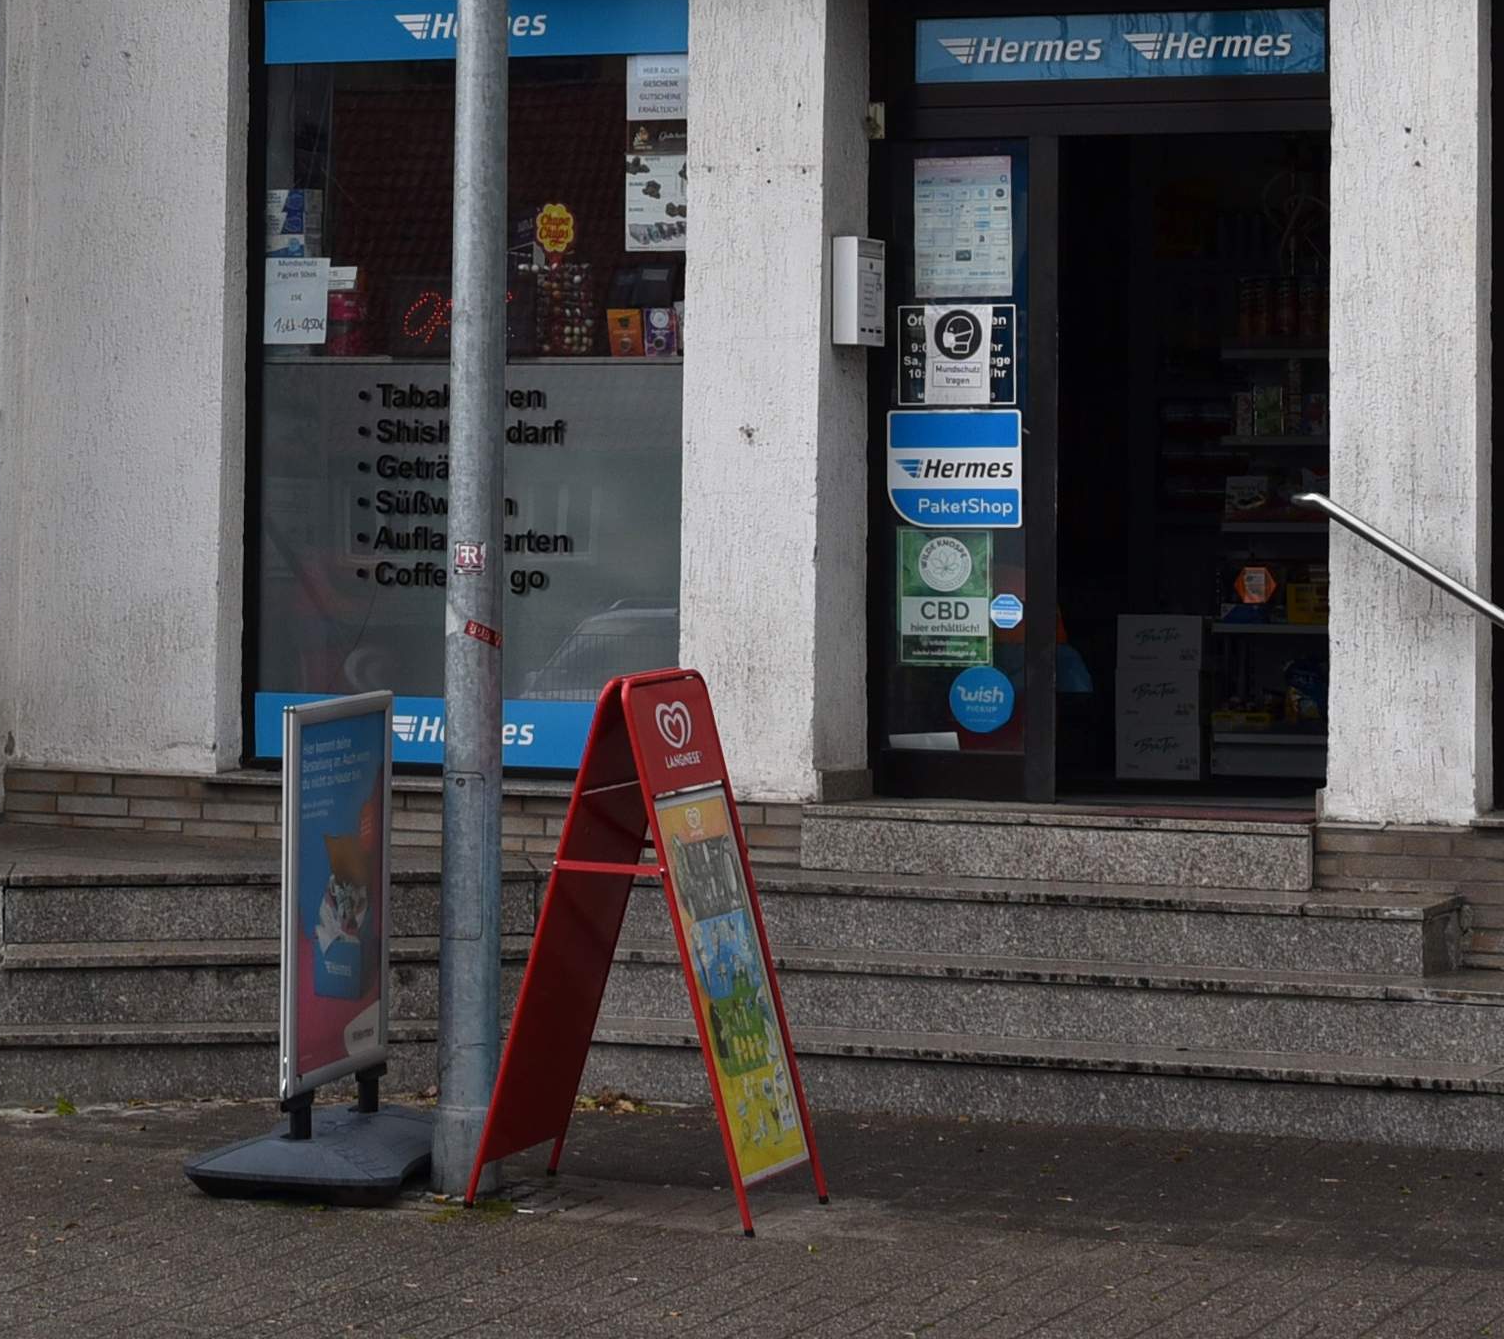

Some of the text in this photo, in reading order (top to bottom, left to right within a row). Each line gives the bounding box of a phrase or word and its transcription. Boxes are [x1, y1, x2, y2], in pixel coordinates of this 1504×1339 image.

[431, 12, 548, 39] Hes
[978, 36, 1102, 65] Hermes
[1163, 32, 1292, 61] Hermes
[639, 93, 682, 101] GUTSCHEINE
[539, 225, 569, 241] Chups
[935, 364, 980, 373] Mundschutz
[945, 376, 970, 386] tragen
[923, 458, 1013, 479] Hermes
[917, 497, 1014, 517] PaketShop
[936, 538, 968, 559] KNOSPE
[510, 568, 547, 595] go
[920, 601, 970, 621] CBD
[910, 623, 981, 633] hier erhältlich!
[956, 685, 1005, 703] wish
[417, 716, 536, 746] Hes
[664, 752, 702, 770] LANGNESE
